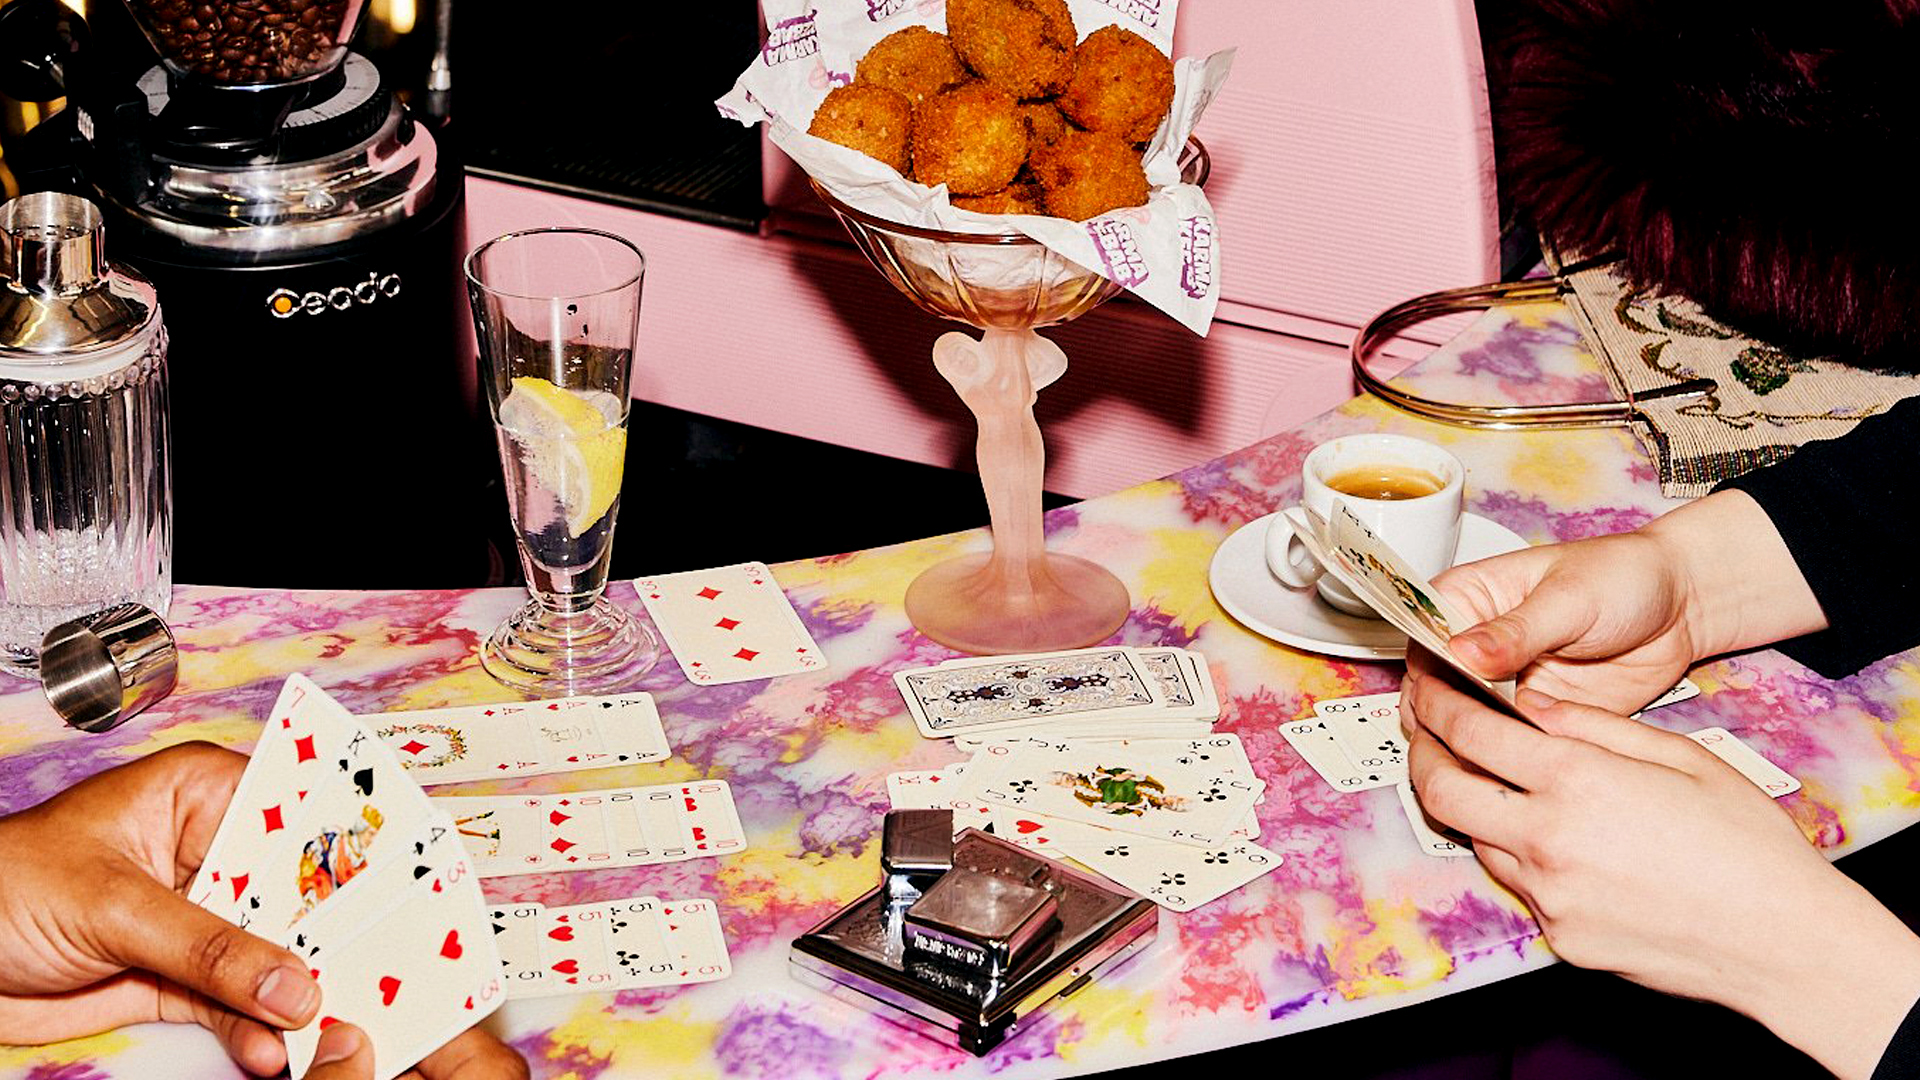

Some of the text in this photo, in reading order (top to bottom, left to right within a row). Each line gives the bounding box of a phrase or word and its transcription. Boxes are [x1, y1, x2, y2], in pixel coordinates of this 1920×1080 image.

[1190, 216, 1212, 299] KARMA
[291, 686, 306, 709] 7
[566, 701, 588, 710] A
[620, 699, 642, 708] A
[1325, 703, 1347, 714] 8
[503, 707, 525, 716] A
[1370, 707, 1392, 718] 8
[1291, 724, 1313, 735] 8
[347, 730, 366, 756] K
[586, 753, 610, 761] A
[636, 752, 659, 760] A
[517, 761, 540, 769] A
[1361, 757, 1384, 767] 8
[898, 775, 921, 786] K
[1340, 777, 1363, 787] 8
[447, 861, 467, 884] 3
[514, 908, 538, 918] 5
[629, 902, 652, 913] 5
[683, 903, 707, 914] 5
[578, 911, 602, 921] 5
[650, 963, 673, 974] 5
[699, 965, 723, 975] 5
[518, 970, 542, 981] 5
[588, 973, 612, 984] 5
[480, 979, 500, 1001] 3
